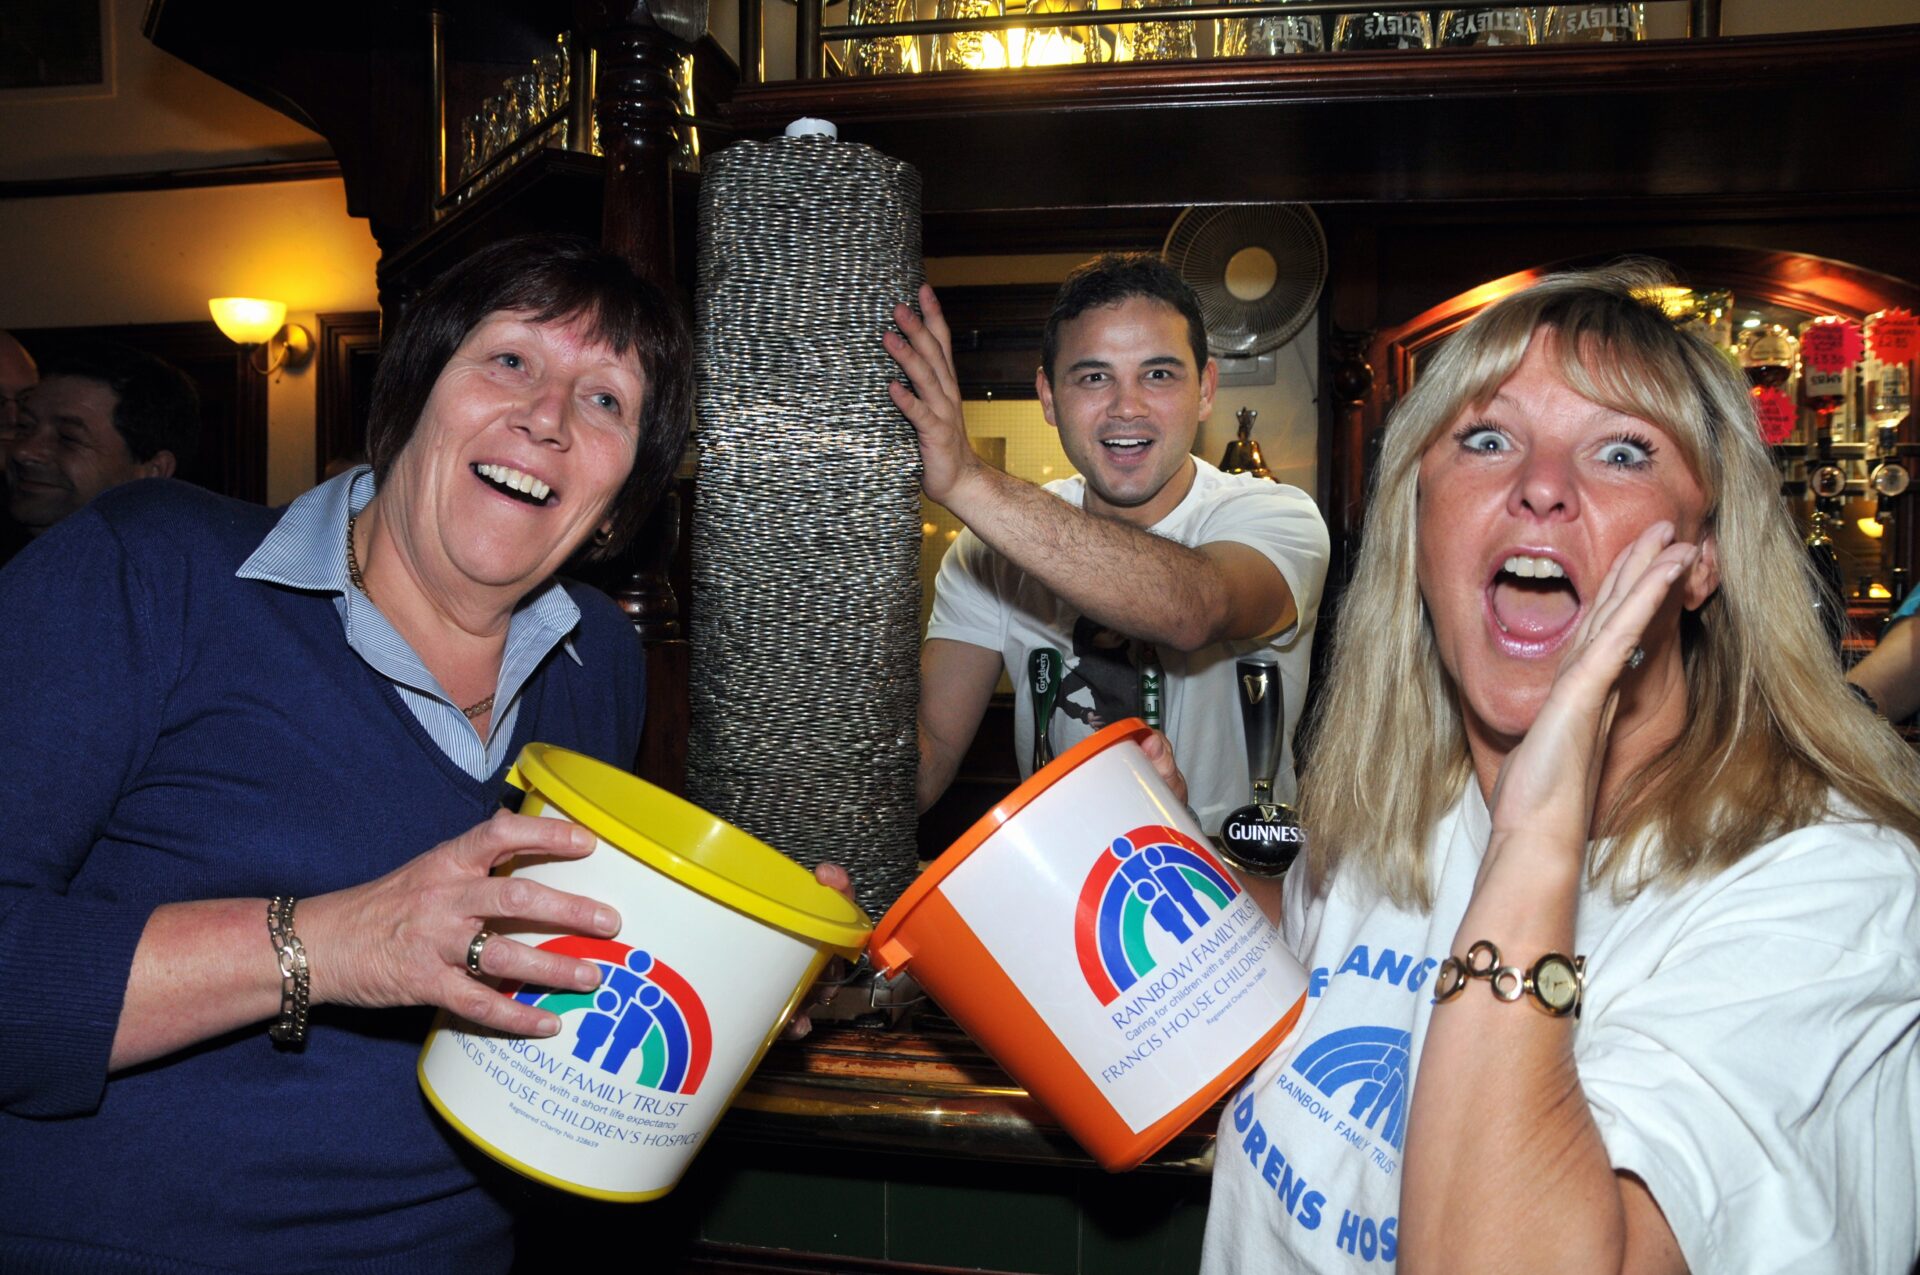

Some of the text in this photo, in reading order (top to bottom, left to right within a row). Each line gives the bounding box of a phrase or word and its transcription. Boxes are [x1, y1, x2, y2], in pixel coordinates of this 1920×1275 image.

[1036, 653, 1050, 693] Carlsberg
[1228, 822, 1307, 844] GUINNESS
[1112, 956, 1194, 1030] RAINBOW
[1192, 919, 1237, 965] FAMILY
[1231, 898, 1257, 927] TRUST
[1125, 1016, 1157, 1042] Caring
[1154, 1005, 1168, 1020] for
[1169, 977, 1203, 1008] children
[1202, 963, 1219, 980] with
[1223, 942, 1242, 961] short
[1101, 1033, 1163, 1084] FRANCIS
[1162, 990, 1216, 1040] HOUSE
[1212, 934, 1272, 996] CHILDREN'S
[1206, 1002, 1232, 1025] Registered
[1231, 988, 1249, 1004] Charity
[485, 1060, 540, 1106] HOUSE
[541, 1099, 642, 1145] CHILDREN'S
[642, 1131, 701, 1148] HOSPICE
[499, 1047, 512, 1062] for
[511, 1060, 547, 1087] children
[549, 1083, 571, 1100] with
[572, 1095, 580, 1104] a
[581, 1099, 608, 1115] short
[609, 1109, 625, 1121] life
[626, 1115, 678, 1130] expectancy
[508, 1102, 540, 1124] Registered
[540, 1120, 562, 1136] Charity
[562, 1066, 632, 1105] FAMILY
[633, 1093, 688, 1118] TRUST
[1276, 1073, 1397, 1176] RAINBOW FAMILY TRUST
[1336, 1208, 1398, 1263] HOS
